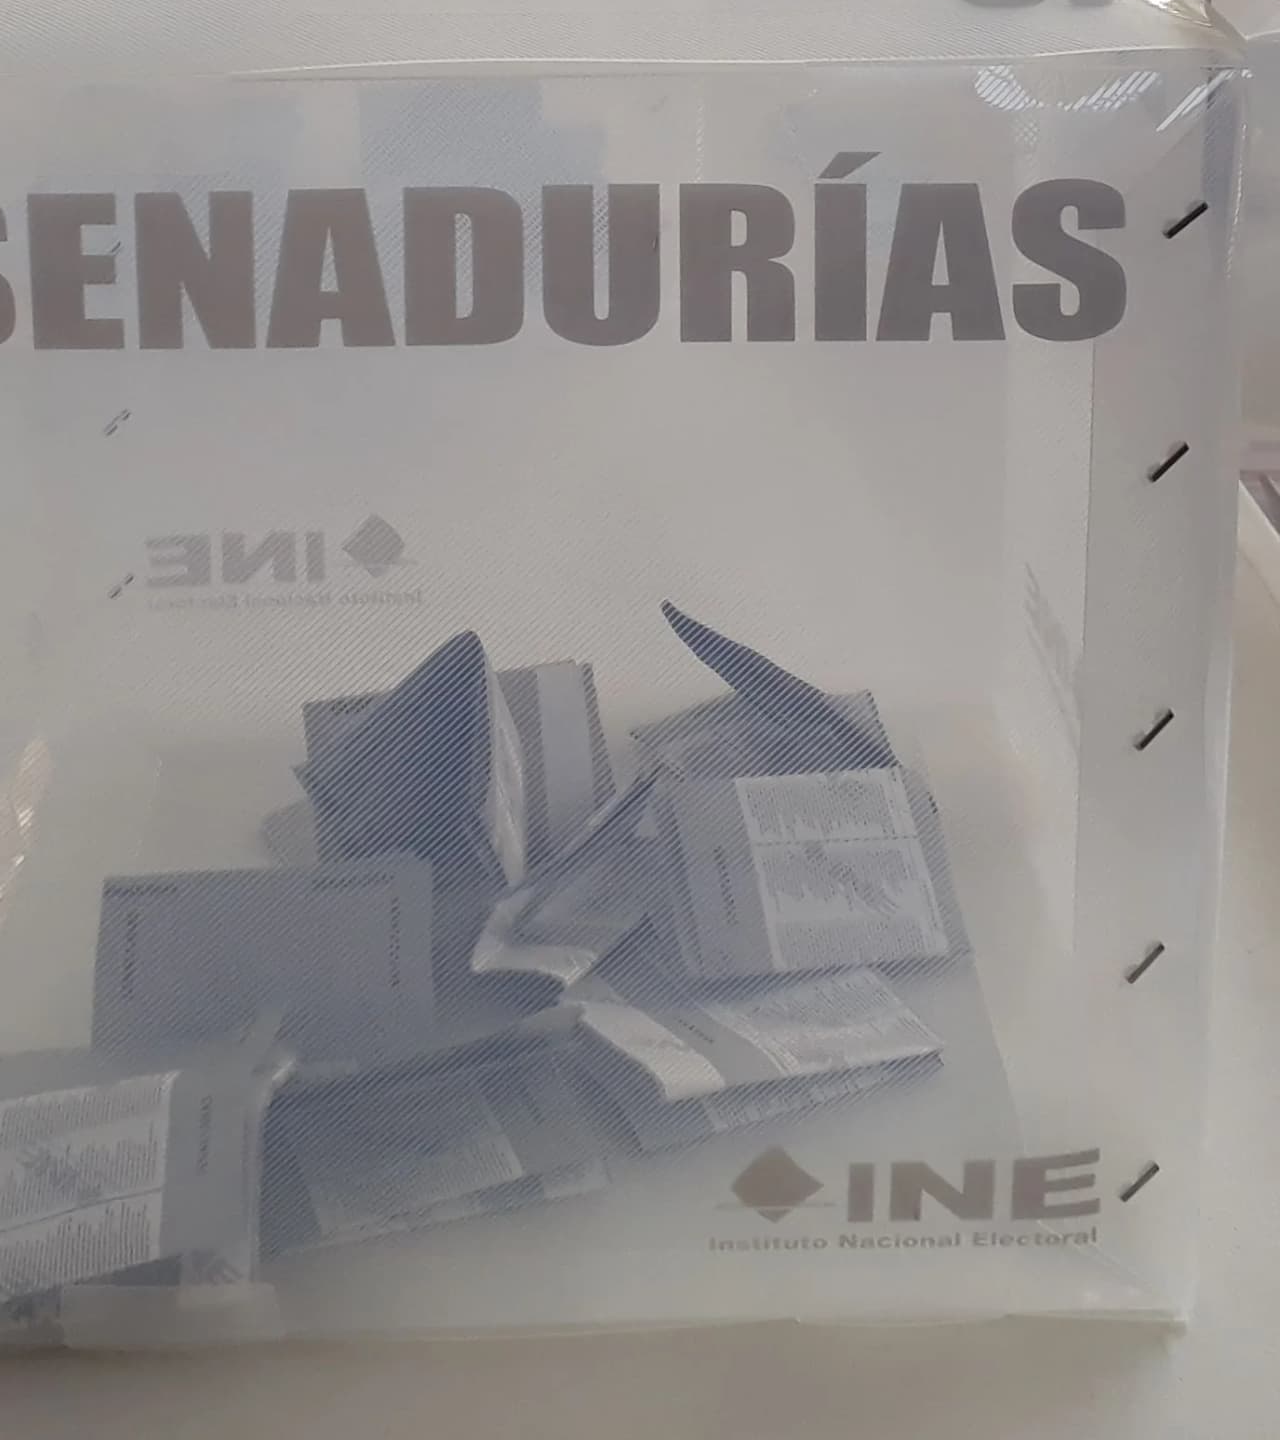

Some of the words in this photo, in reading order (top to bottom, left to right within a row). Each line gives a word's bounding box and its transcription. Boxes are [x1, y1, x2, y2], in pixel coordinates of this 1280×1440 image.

[846, 1146, 1101, 1224] INE
[708, 1233, 829, 1252] Instituto
[838, 1230, 961, 1251] Nacional
[971, 1226, 1099, 1249] Electoral
